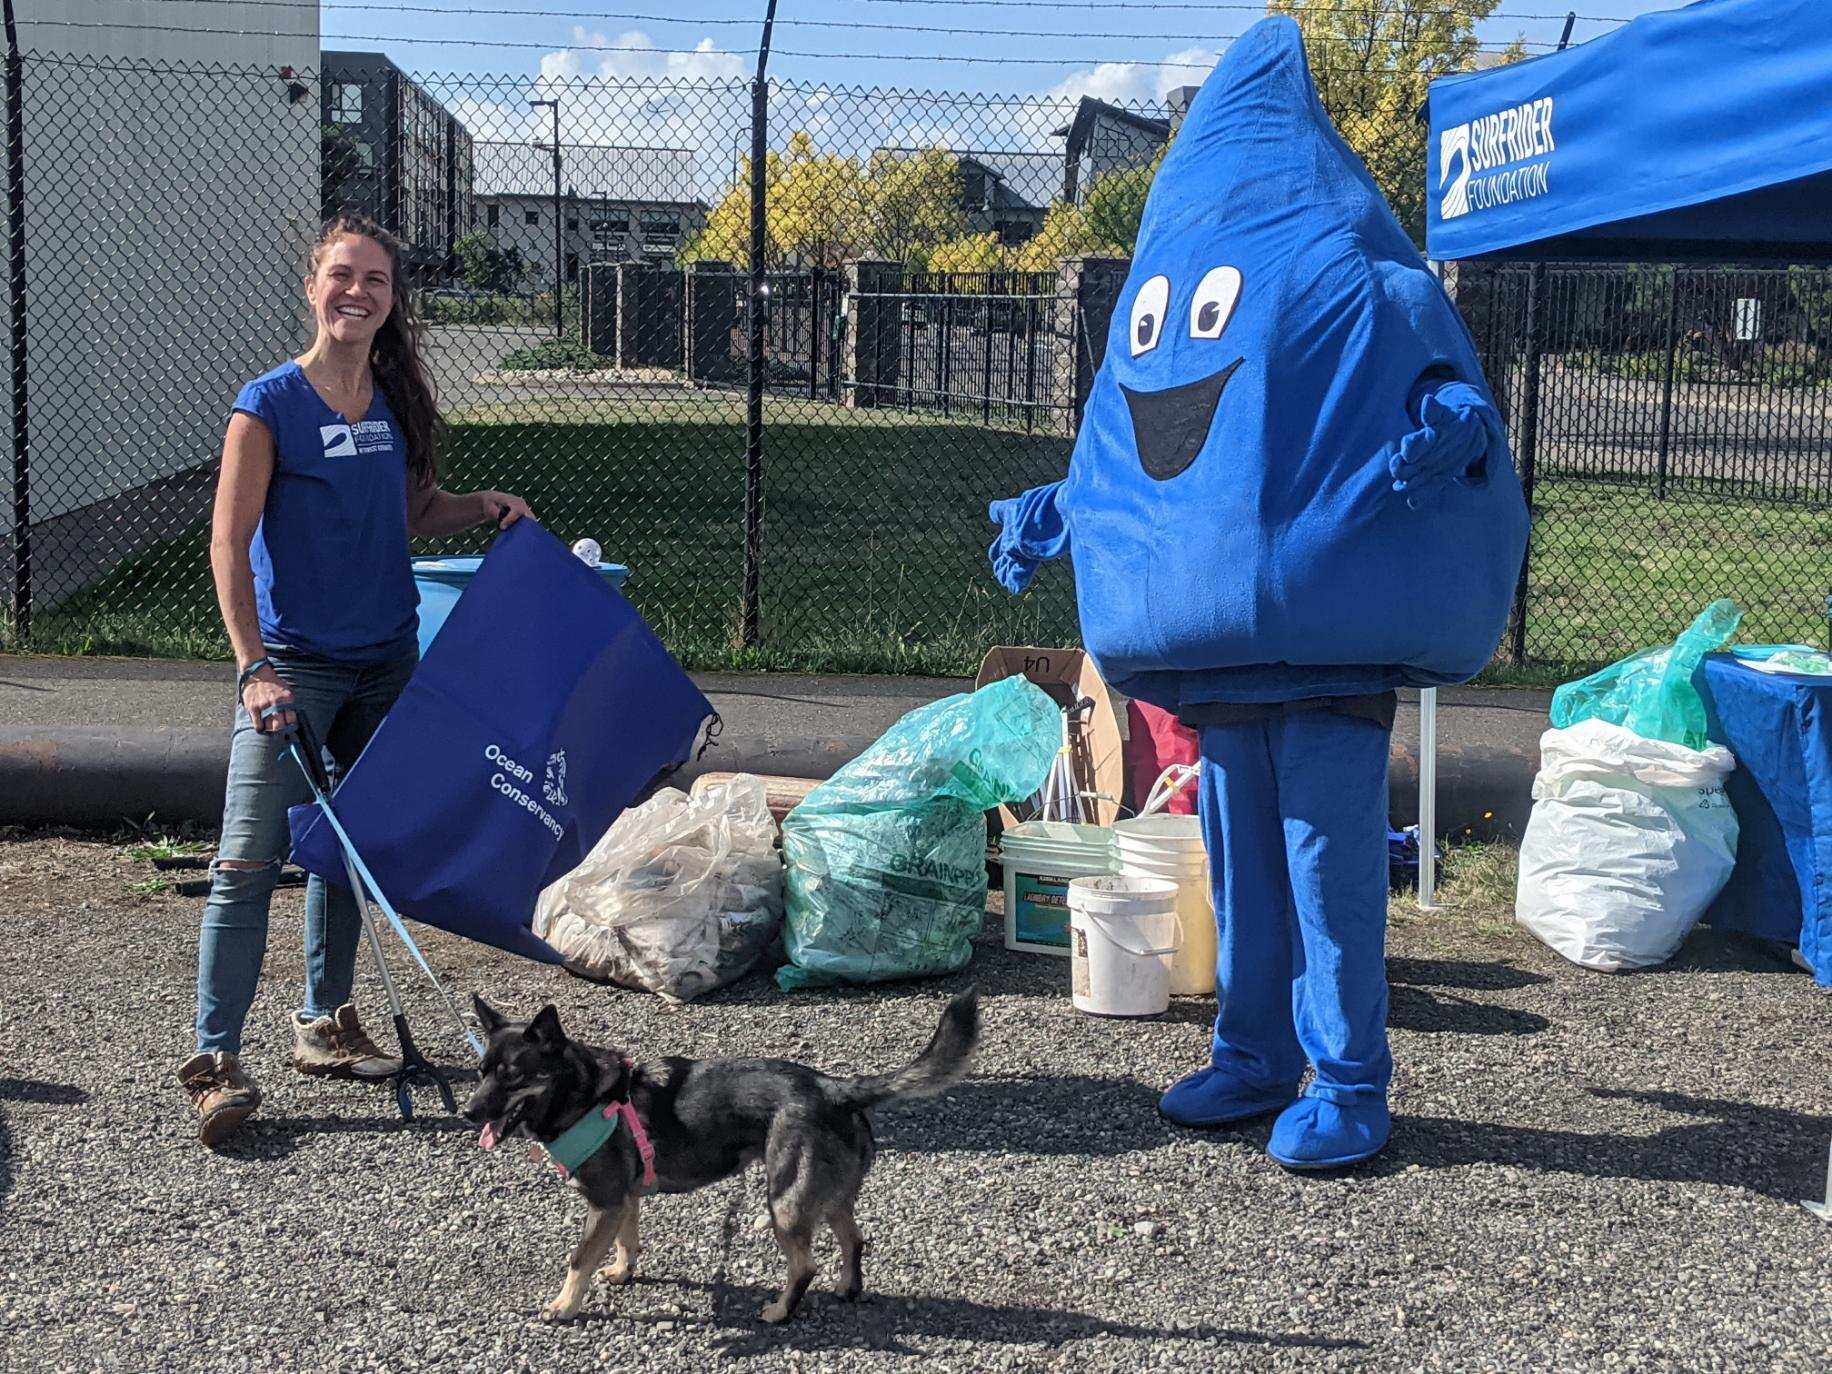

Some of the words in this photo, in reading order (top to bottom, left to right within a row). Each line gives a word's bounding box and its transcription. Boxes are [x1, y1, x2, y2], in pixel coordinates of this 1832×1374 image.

[1471, 97, 1555, 172] SURFRIDER
[1467, 161, 1550, 212] FOUNDATION
[1023, 655, 1050, 673] U4
[485, 744, 533, 783] Ocean
[491, 773, 565, 841] Conservancy
